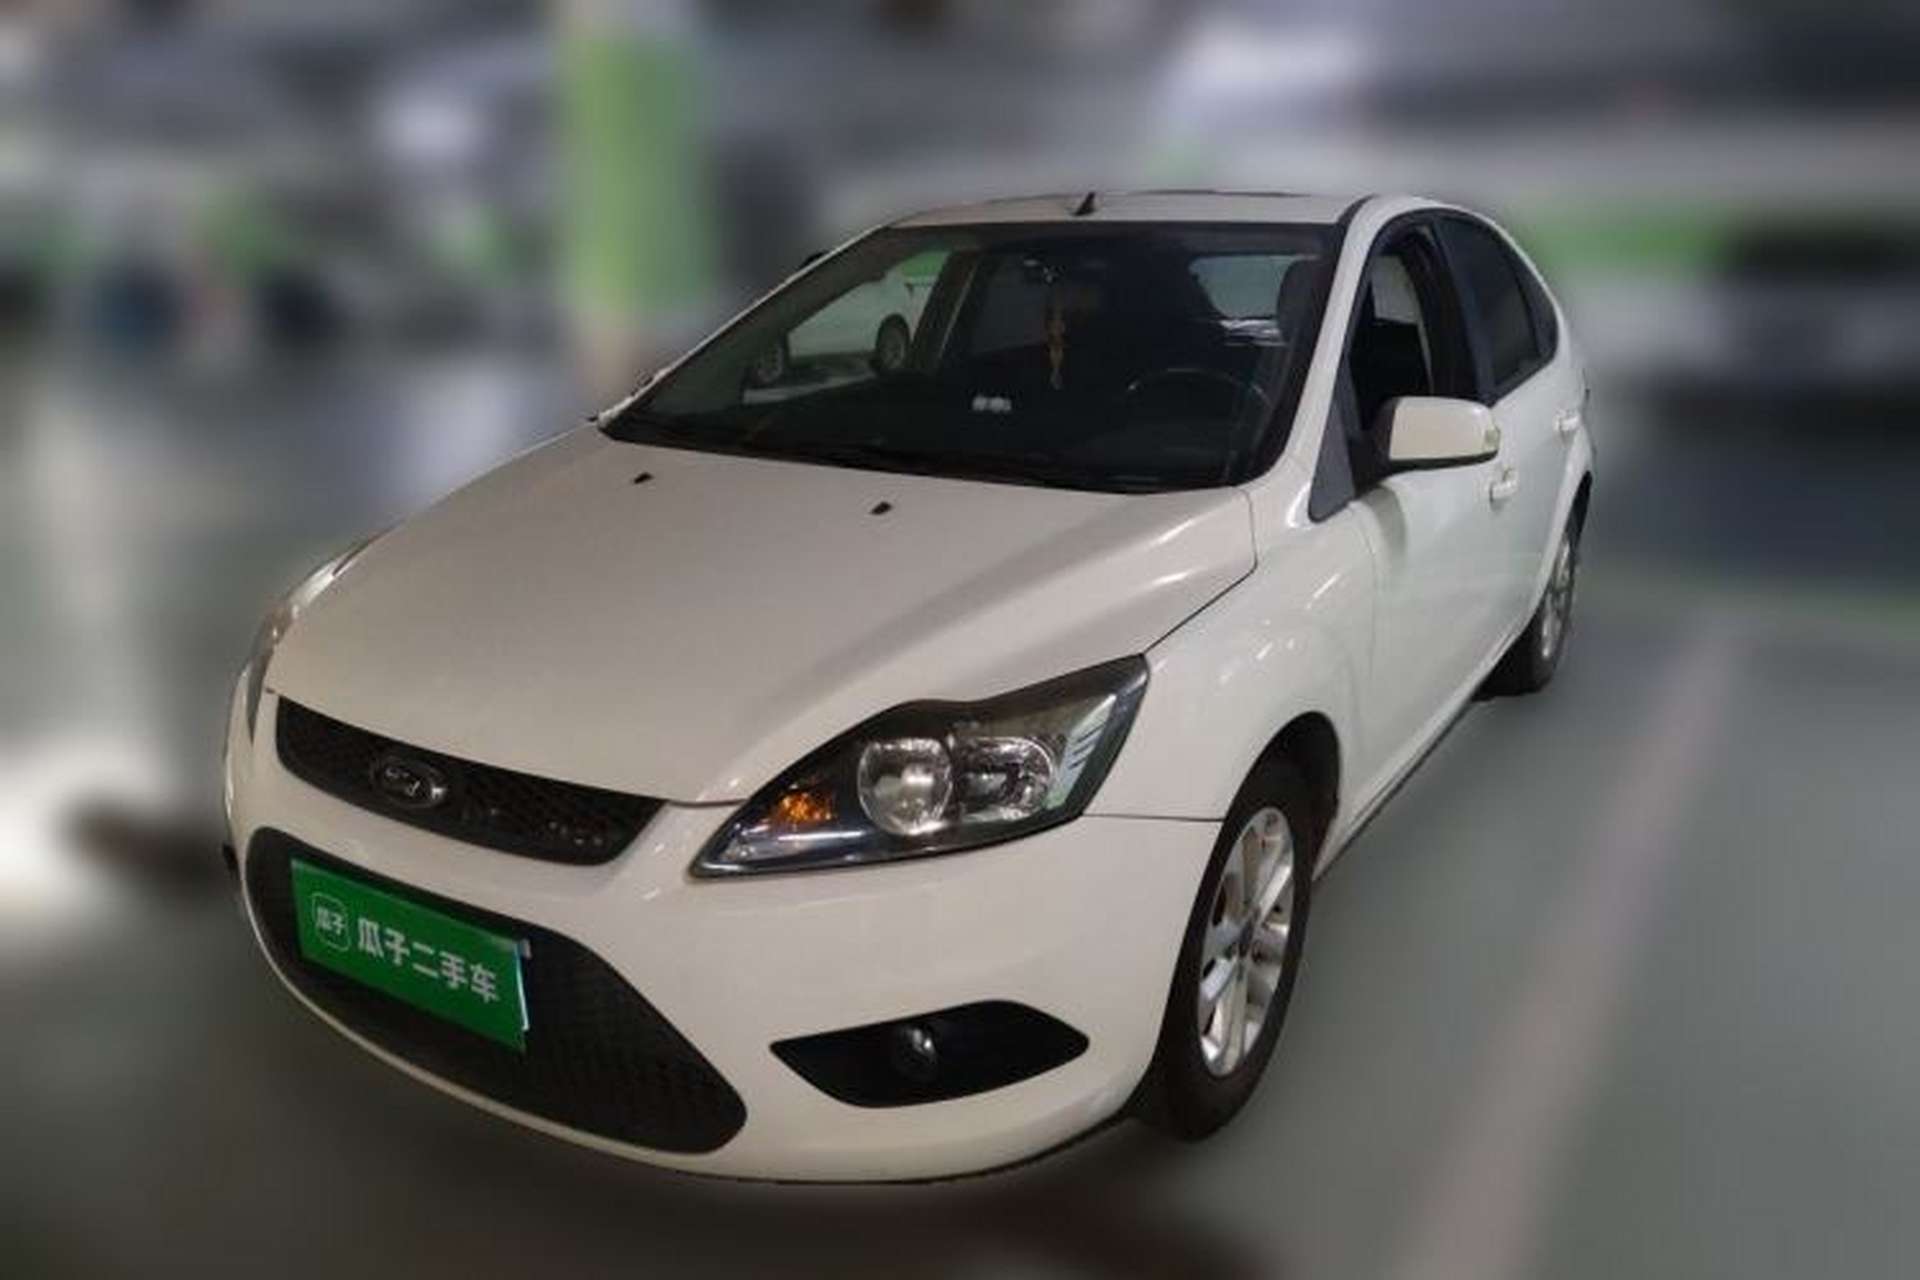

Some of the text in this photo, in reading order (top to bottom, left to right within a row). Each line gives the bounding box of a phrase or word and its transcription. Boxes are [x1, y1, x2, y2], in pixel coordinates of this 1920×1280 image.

[316, 906, 347, 935] 瓜子
[357, 917, 500, 1004] 瓜子二手车
